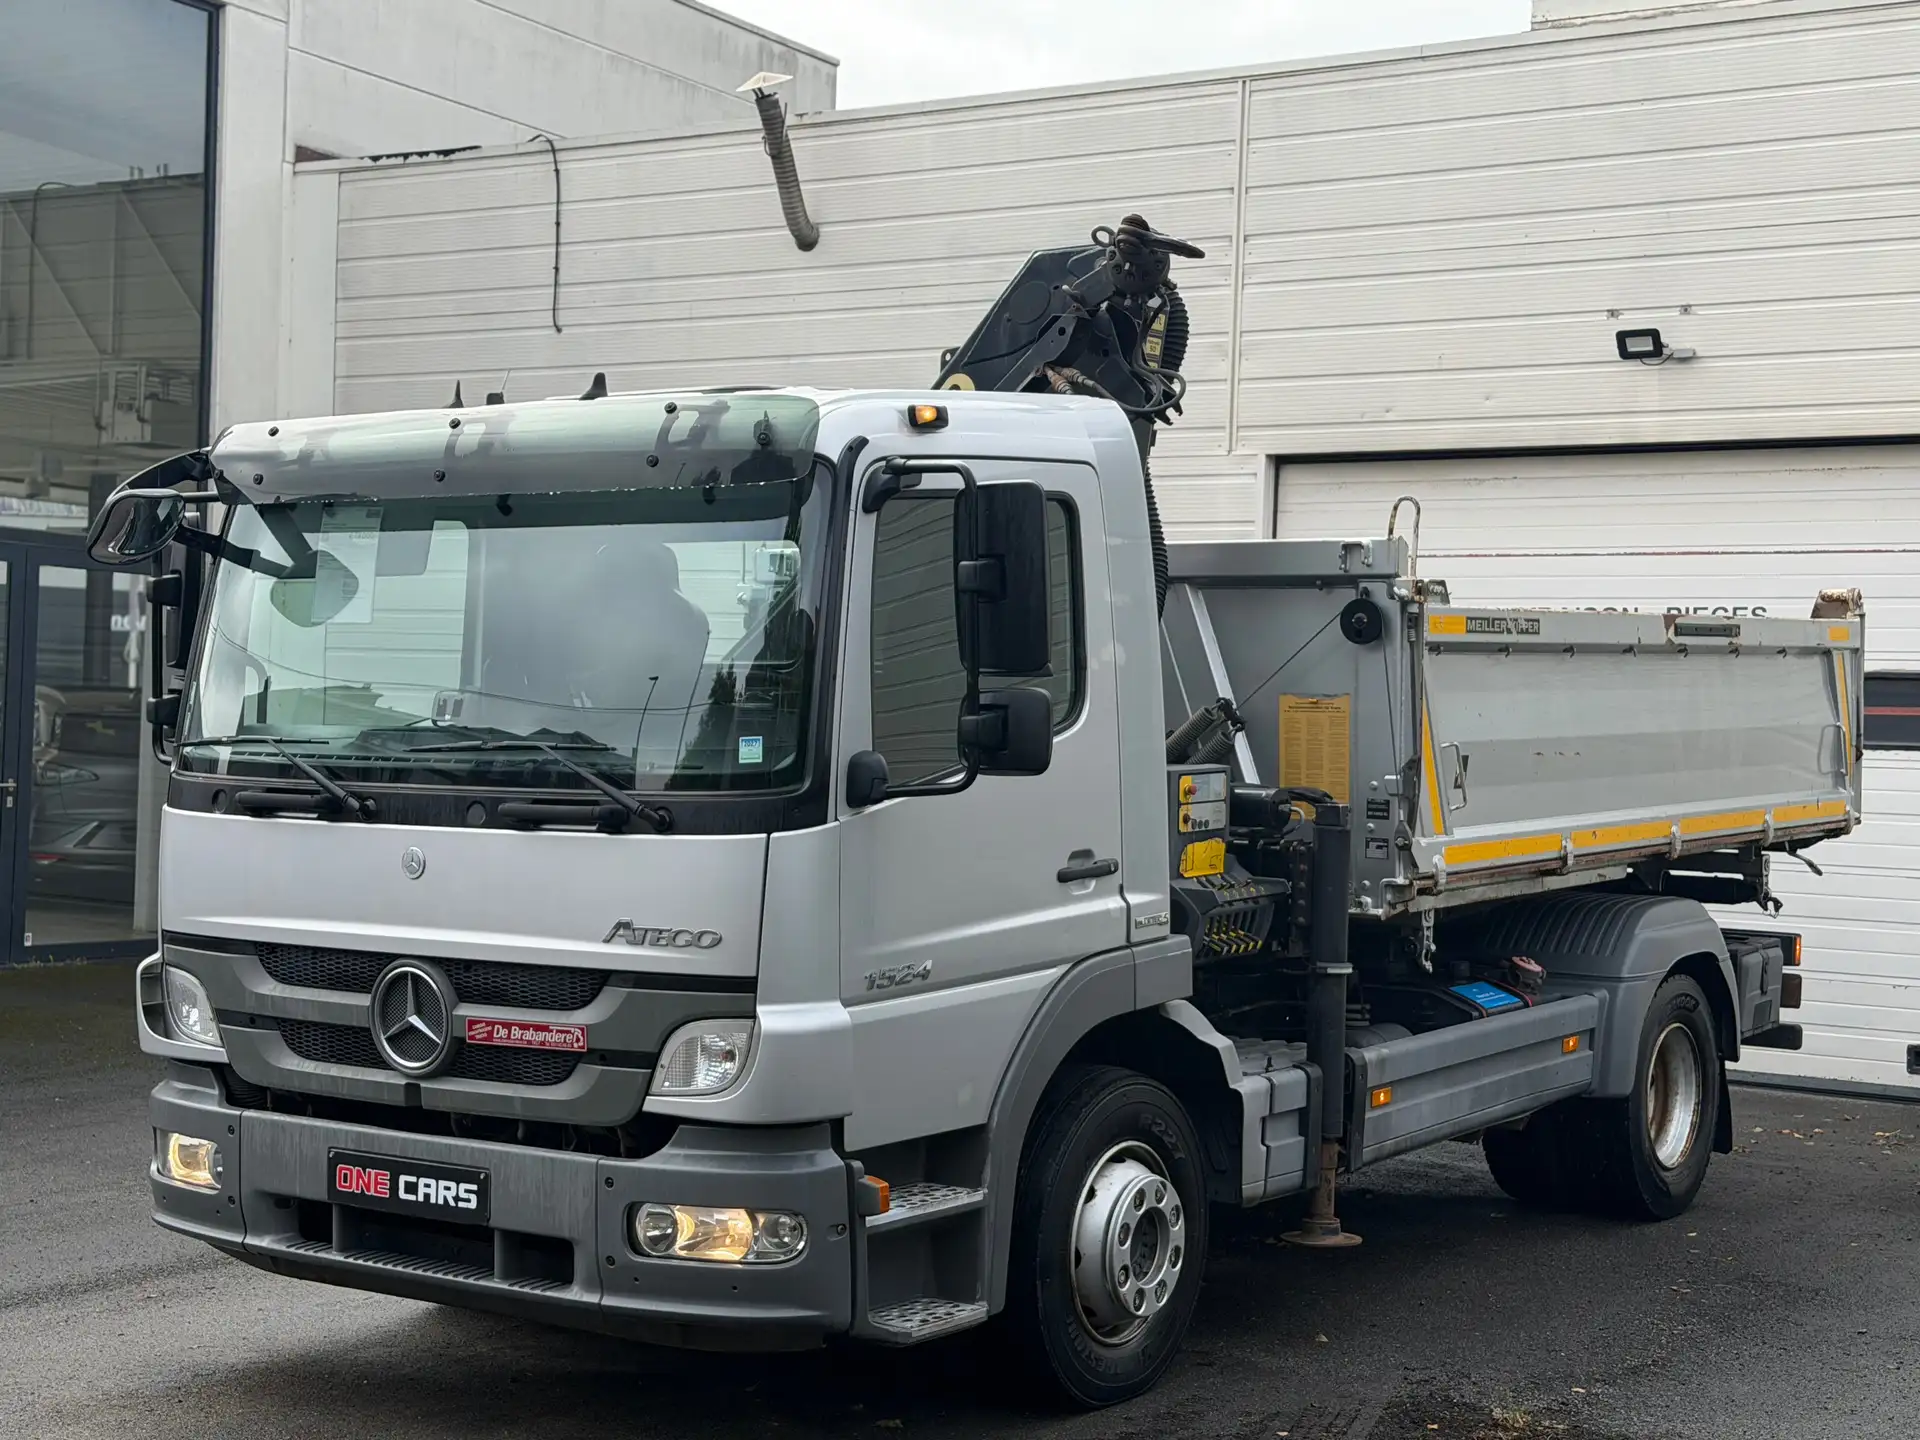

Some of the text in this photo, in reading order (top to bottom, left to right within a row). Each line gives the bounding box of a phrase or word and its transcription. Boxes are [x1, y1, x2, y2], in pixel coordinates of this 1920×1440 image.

[602, 917, 723, 949] ATEGO
[863, 959, 934, 992] 1524
[493, 1024, 509, 1038] De
[510, 1026, 573, 1043] Brabandere
[336, 1164, 478, 1209] ONE CARS
